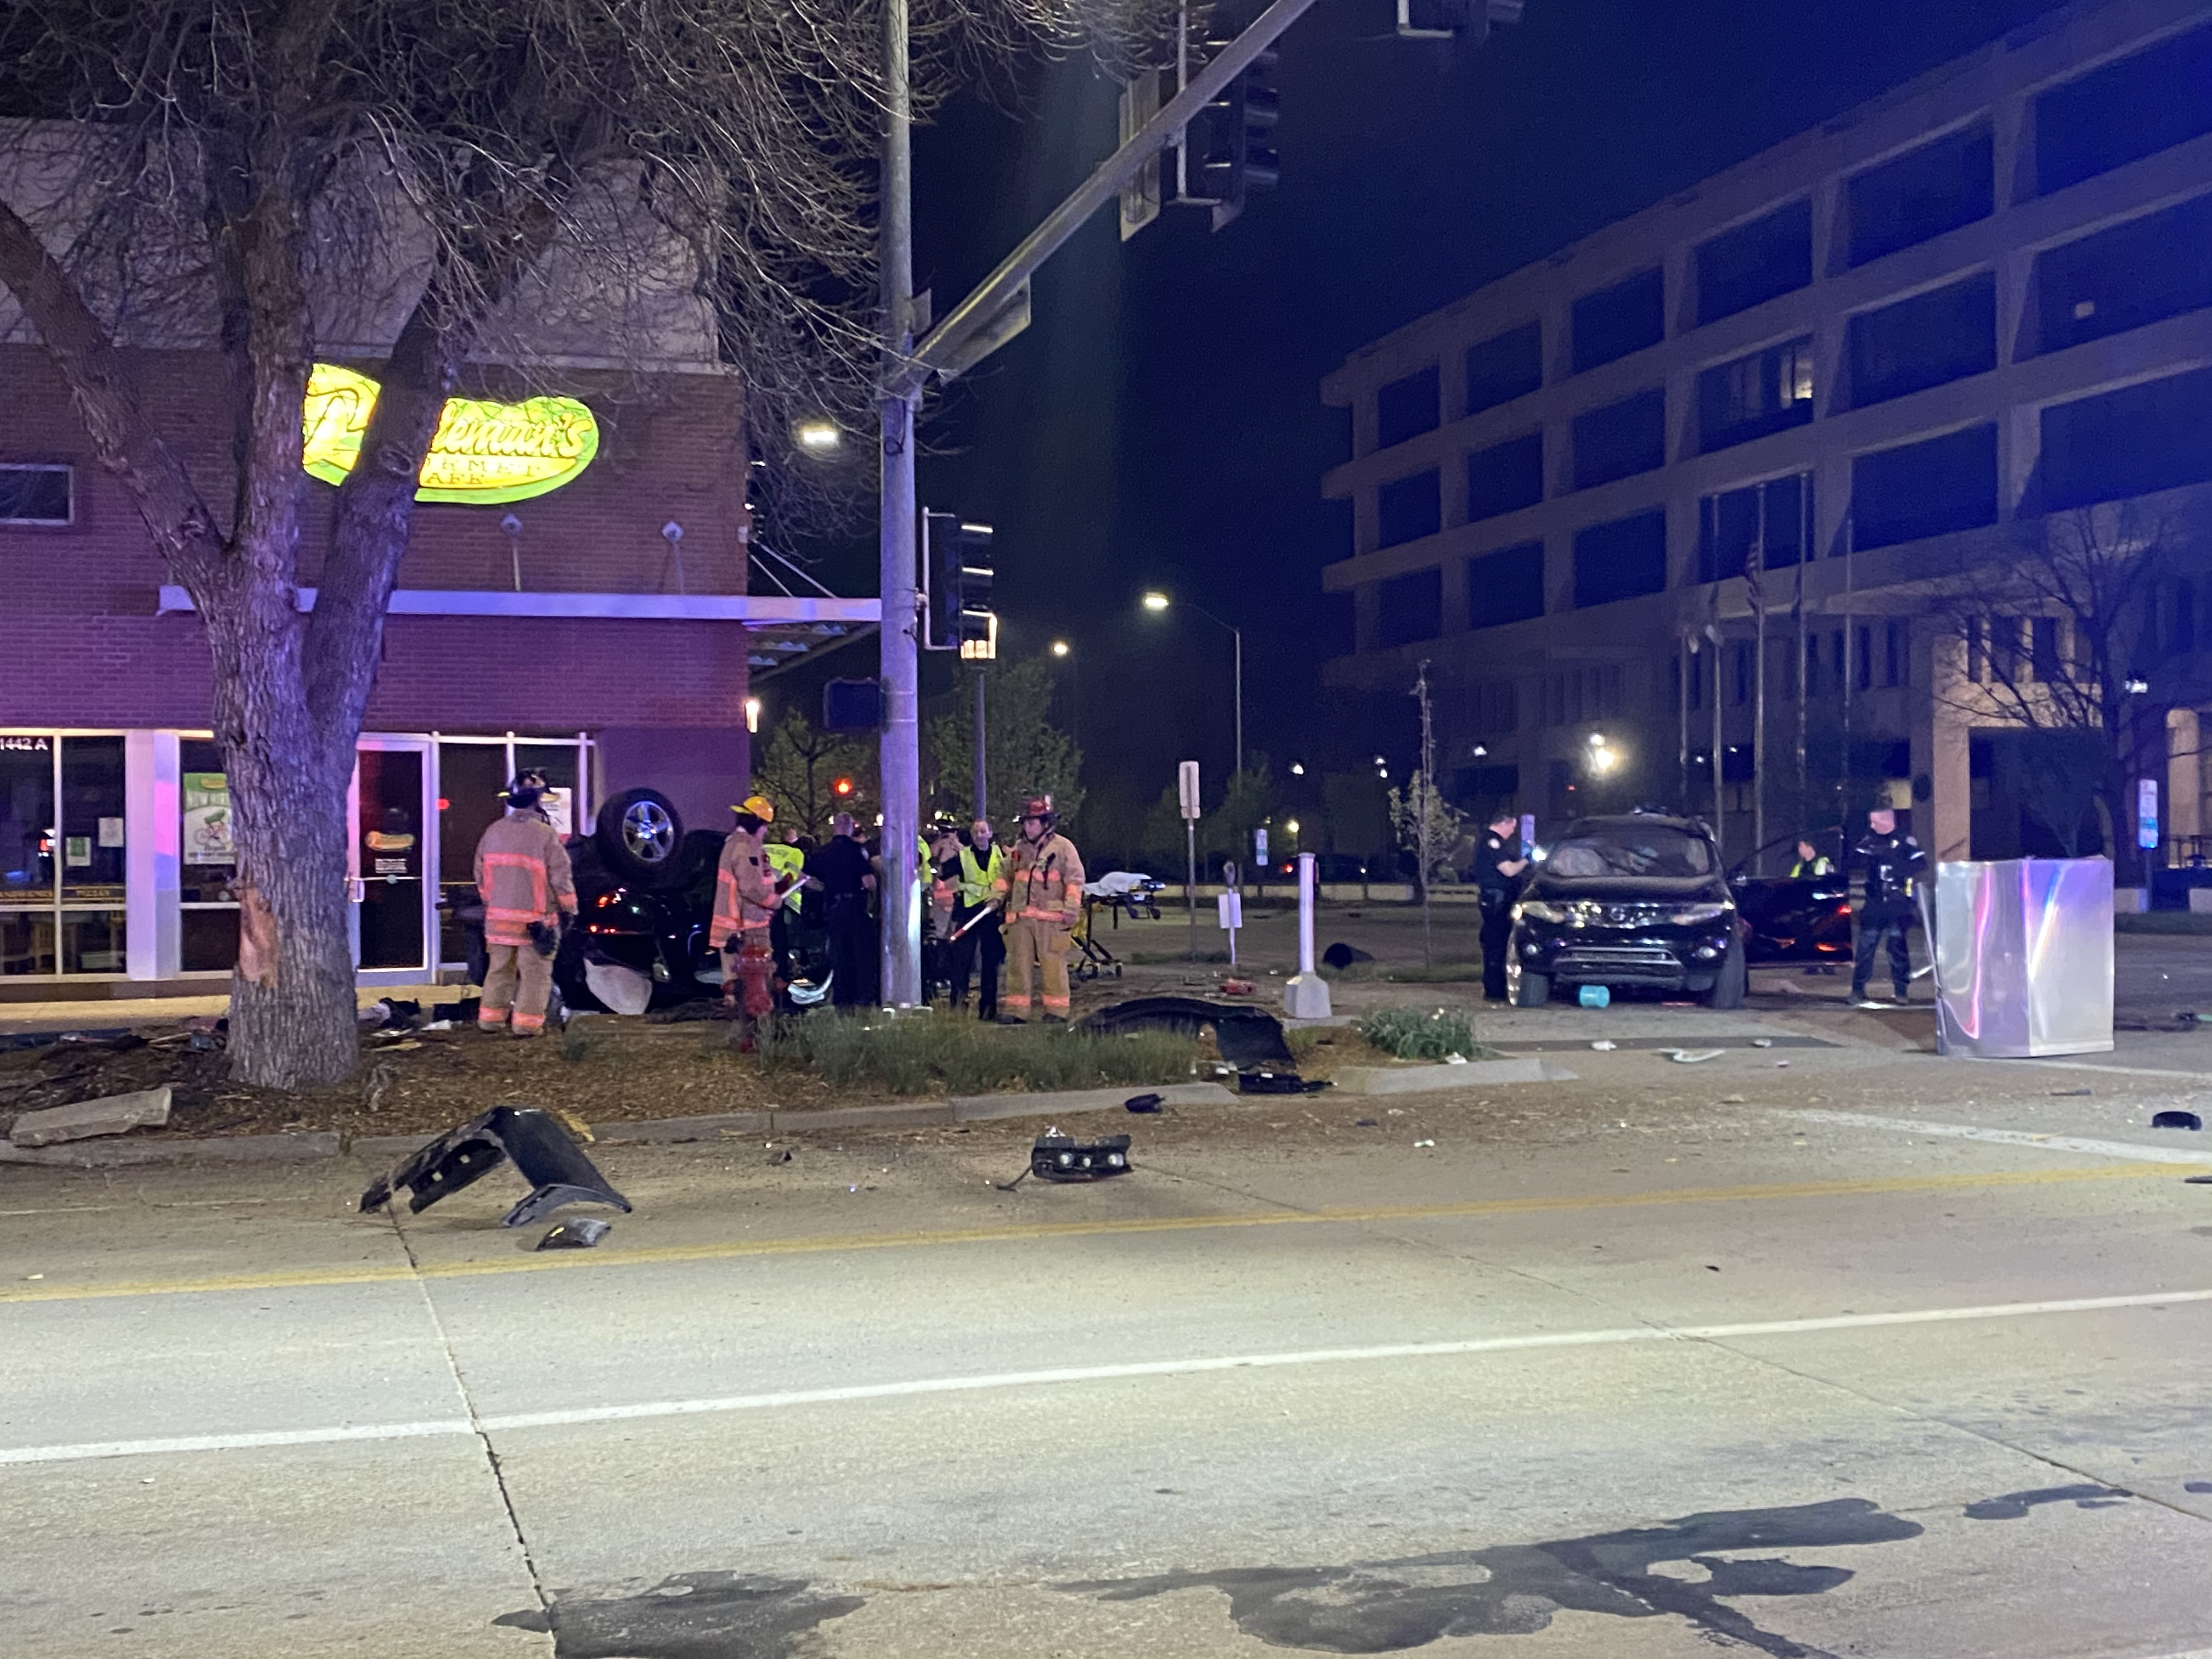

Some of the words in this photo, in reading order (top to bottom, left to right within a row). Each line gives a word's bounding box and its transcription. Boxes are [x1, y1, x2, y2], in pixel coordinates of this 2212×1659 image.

[424, 472, 484, 485] AFE
[0, 738, 33, 751] 1442
[35, 738, 48, 751] A
